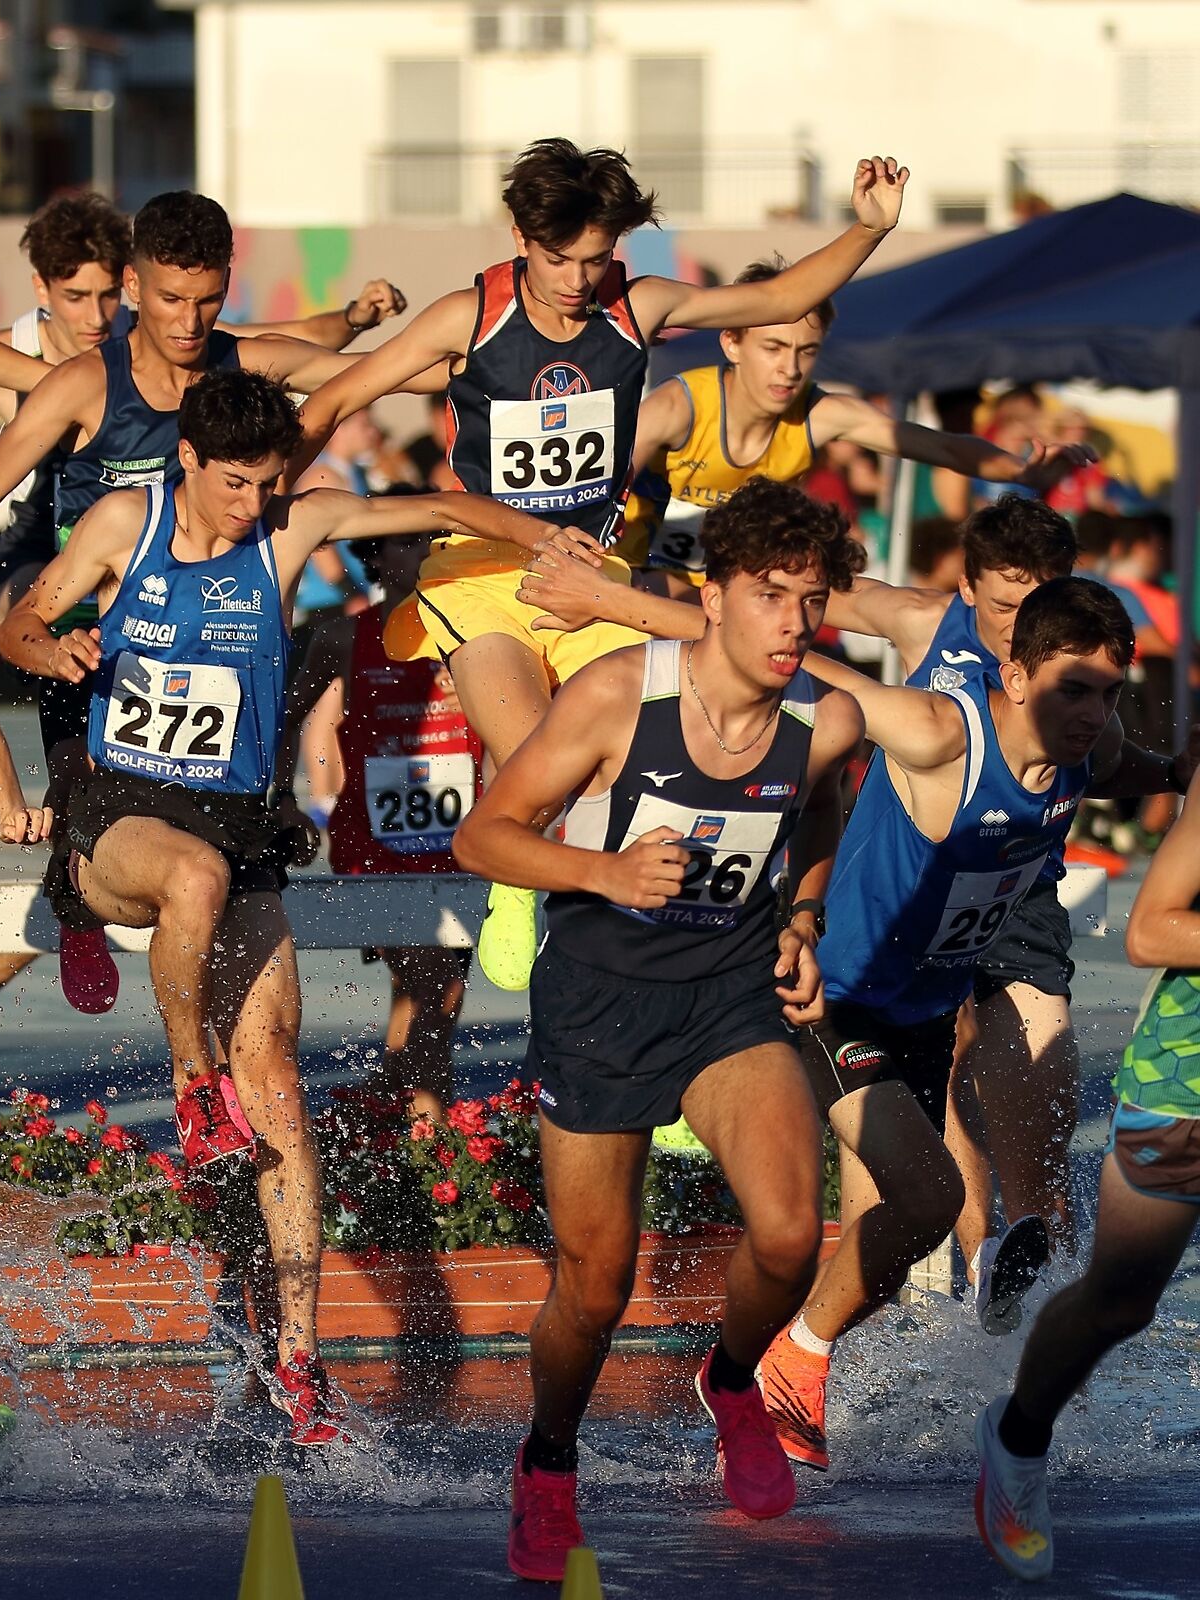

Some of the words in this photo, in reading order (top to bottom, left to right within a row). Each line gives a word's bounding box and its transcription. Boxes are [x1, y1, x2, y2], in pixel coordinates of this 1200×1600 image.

[503, 431, 605, 489] 332
[577, 484, 608, 504] 2024
[133, 619, 177, 643] RUGI
[213, 631, 259, 642] FIDEURAM
[115, 696, 225, 756] 272
[106, 749, 184, 777] MOLFETTA
[186, 765, 223, 779] 2024
[375, 788, 462, 833] 280
[682, 851, 752, 904] 26
[697, 911, 734, 927] 2024
[936, 901, 1008, 951] 29
[921, 955, 984, 970] MOLFET
[846, 1044, 876, 1058] ATLETIC
[850, 1057, 881, 1070] VENETA
